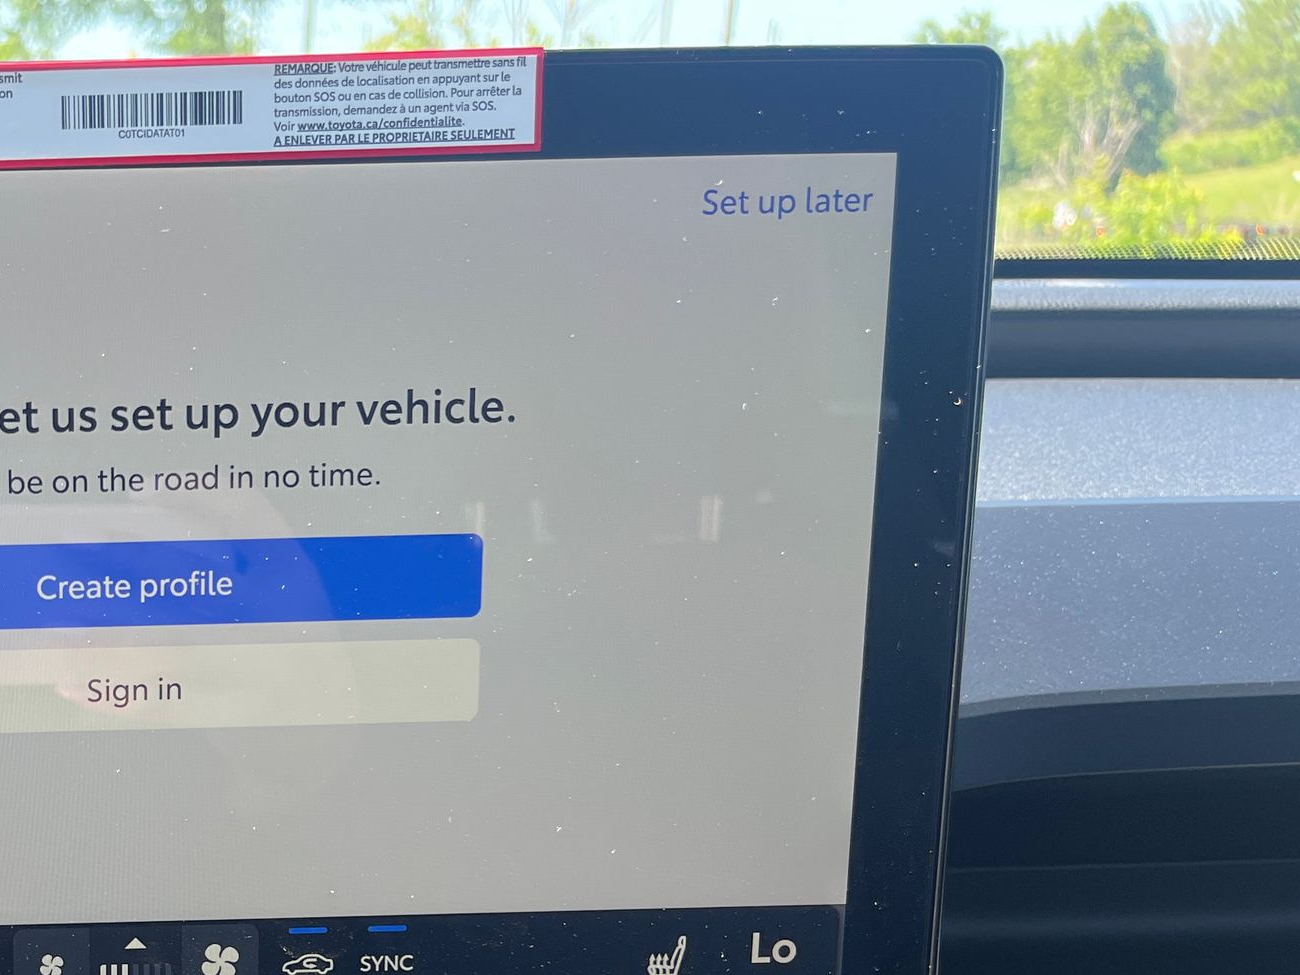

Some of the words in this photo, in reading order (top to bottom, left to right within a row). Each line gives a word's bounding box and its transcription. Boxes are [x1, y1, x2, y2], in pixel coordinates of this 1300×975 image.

[274, 62, 337, 75] REMARQUE:
[338, 62, 364, 73] Votre
[366, 60, 407, 71] véhicule
[408, 60, 432, 73] peut
[433, 58, 490, 70] transmettre
[492, 59, 514, 68] sans
[516, 56, 527, 67] fil
[274, 79, 293, 89] des
[295, 77, 339, 88] données
[341, 76, 355, 87] de
[357, 75, 415, 87] localisation
[417, 76, 430, 84] en
[432, 73, 481, 86] appuyant
[483, 74, 499, 83] sur
[501, 71, 511, 82] le
[274, 93, 311, 103] bouton
[314, 91, 336, 102] SOS
[338, 93, 351, 102] ou
[354, 93, 366, 101] en
[368, 92, 386, 100] cas
[387, 89, 401, 100] de
[403, 88, 448, 99] collision.
[450, 87, 474, 98] Pour
[476, 86, 510, 97] arrêter
[512, 85, 522, 96] la
[274, 106, 341, 118] transmission,
[343, 104, 398, 115] demandez
[400, 103, 406, 114] à
[408, 105, 421, 113] un
[424, 103, 454, 115] agent
[455, 102, 470, 112] via
[472, 101, 496, 111] SOS.
[274, 121, 295, 132] Voir
[297, 116, 465, 132] www.toyota.ca/confidentialite.
[273, 136, 282, 147] A
[284, 135, 332, 146] ENLEVER
[334, 134, 355, 146] PAR
[357, 133, 370, 145] LE
[372, 131, 448, 144] PROPRIETAIRE
[450, 128, 516, 142] SEULEMENT
[702, 189, 749, 216] Set
[759, 193, 796, 220] up
[806, 186, 873, 213] later
[51, 404, 97, 433] us
[111, 398, 173, 432] set
[185, 401, 239, 439] up
[251, 400, 346, 438] your
[356, 387, 515, 426] vehicle.
[8, 469, 43, 495] be
[51, 474, 88, 494] on
[97, 467, 144, 493] the
[154, 464, 219, 491] road
[229, 464, 253, 489] in
[264, 467, 300, 489] no
[309, 462, 381, 488] time.
[36, 574, 131, 601] Create
[140, 570, 233, 604] profile
[87, 678, 148, 708] Sign
[158, 677, 182, 701] in
[750, 932, 797, 965] Lo
[360, 954, 414, 973] SYNC
